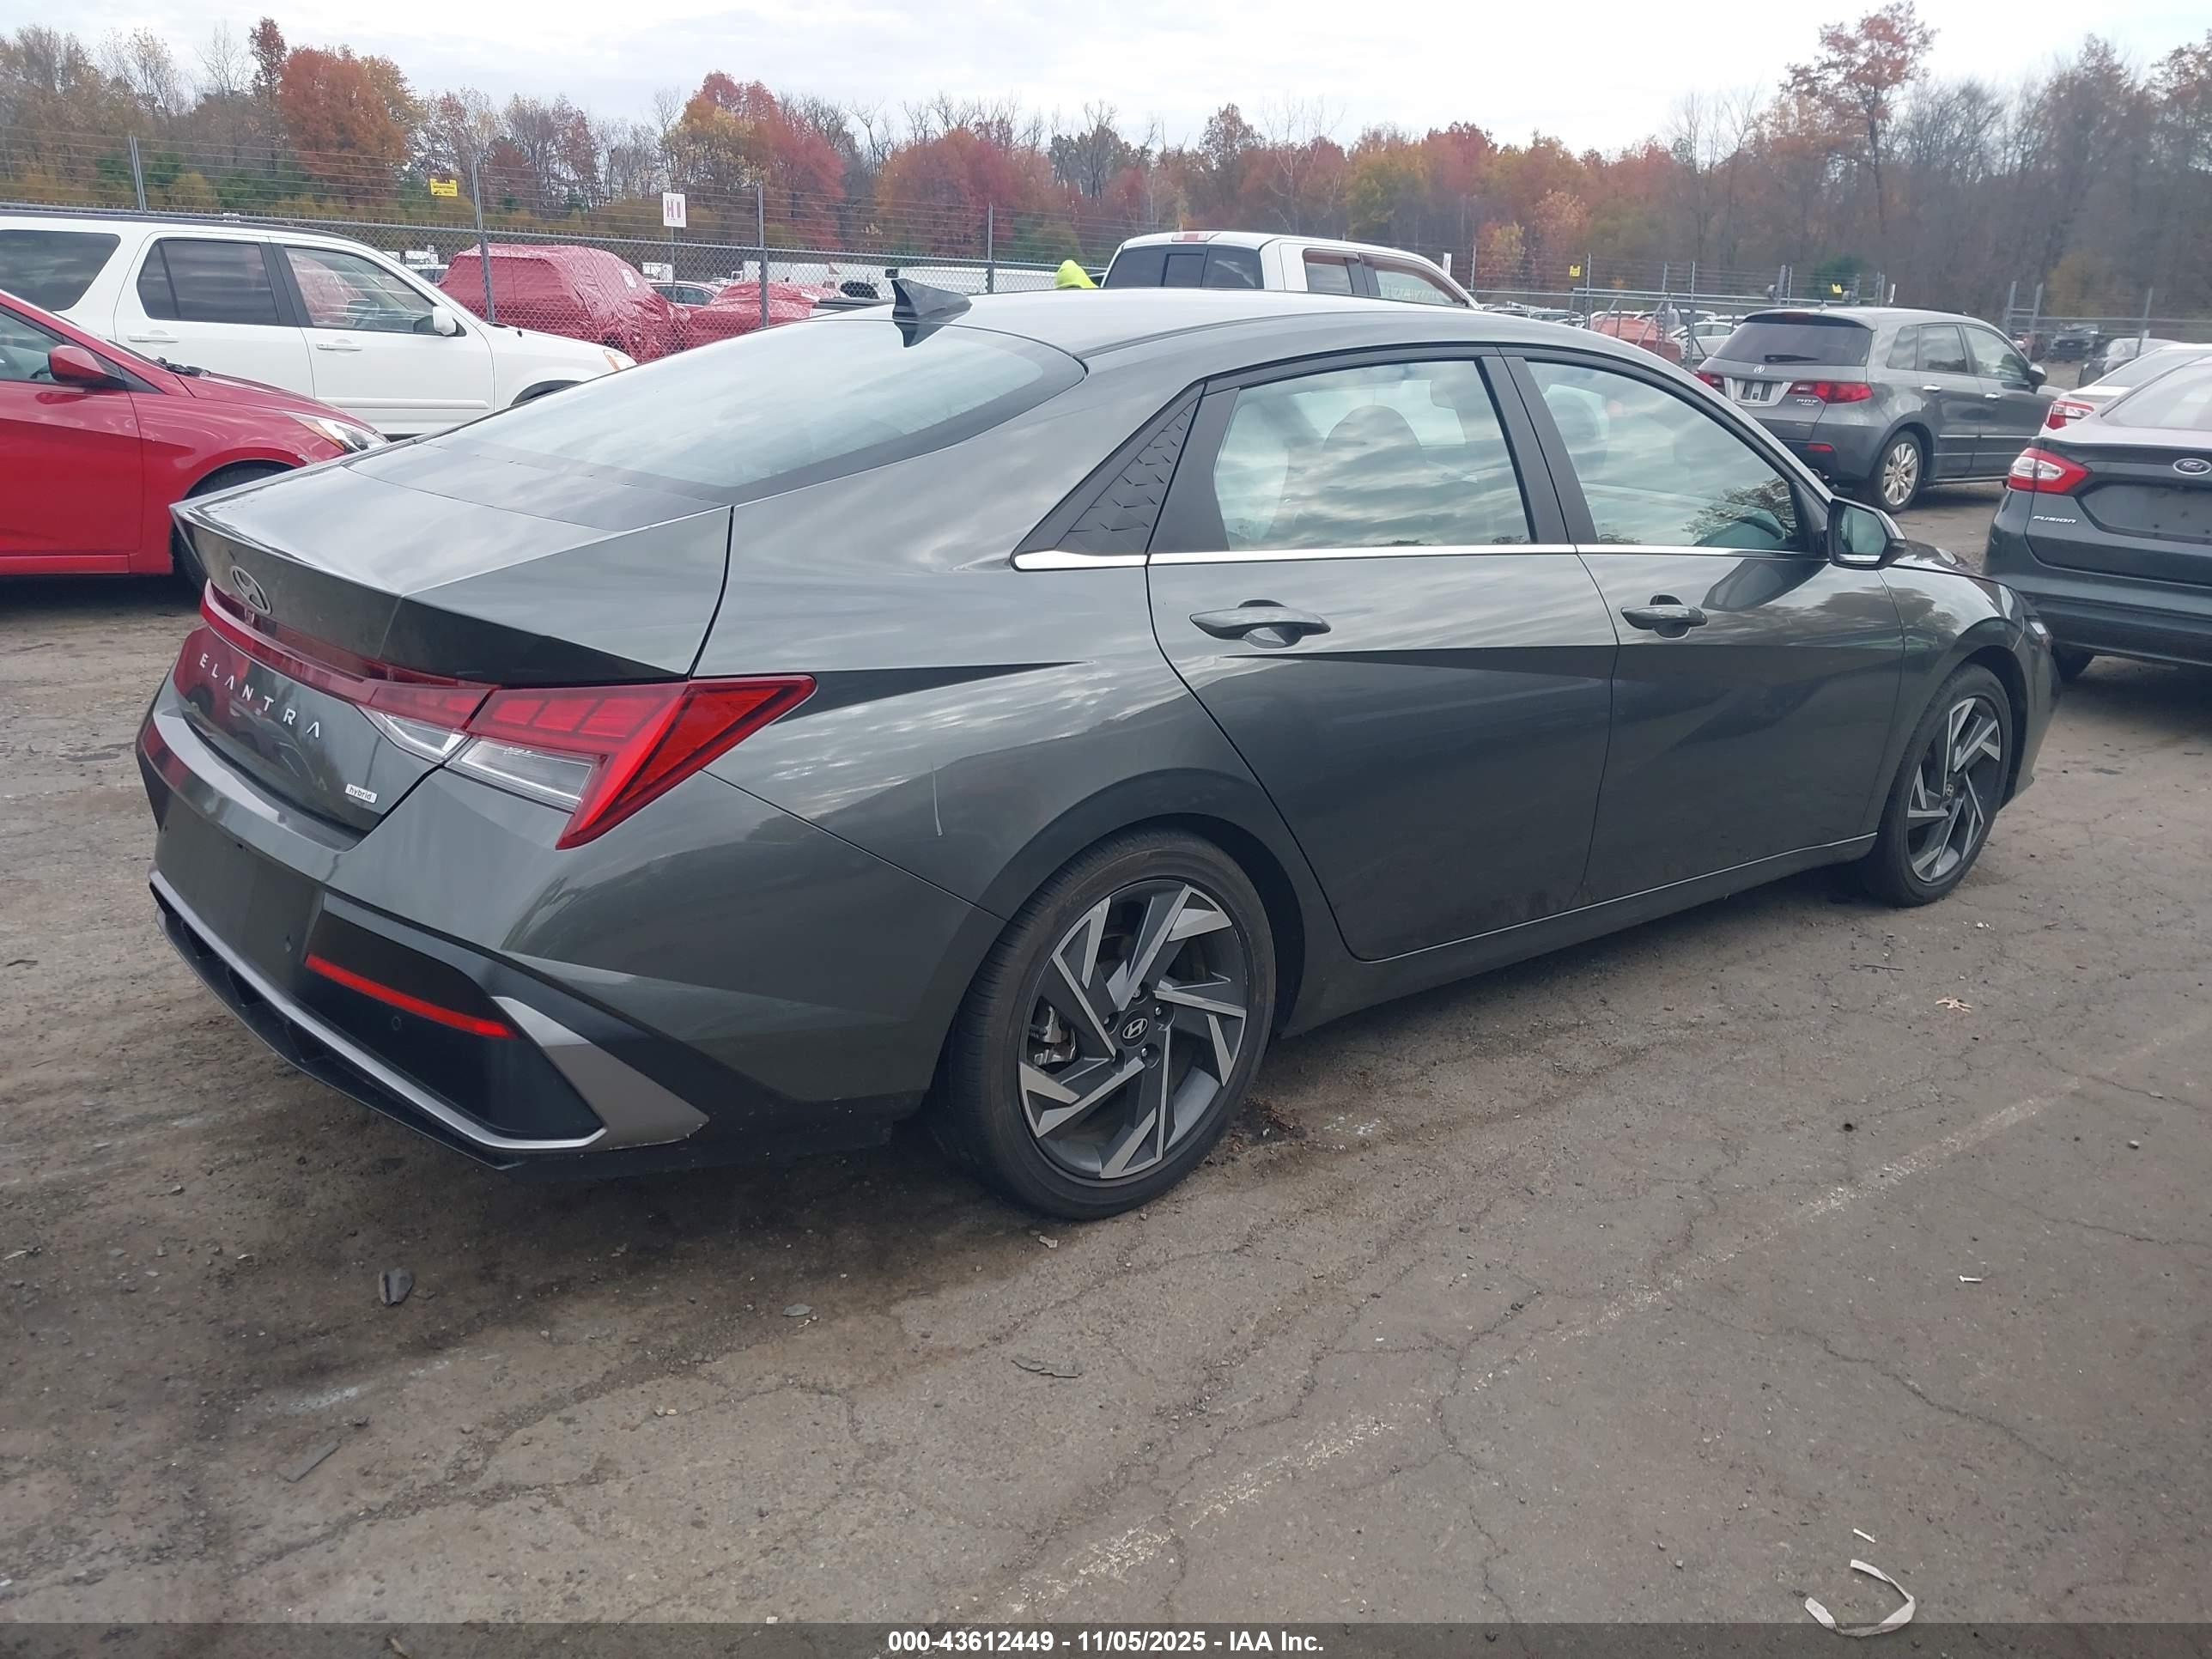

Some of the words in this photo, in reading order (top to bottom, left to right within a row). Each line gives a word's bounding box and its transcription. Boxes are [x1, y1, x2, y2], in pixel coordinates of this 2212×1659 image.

[2033, 515, 2077, 524] FUSION
[199, 653, 319, 738] ELANTRA
[349, 786, 373, 800] hybrid
